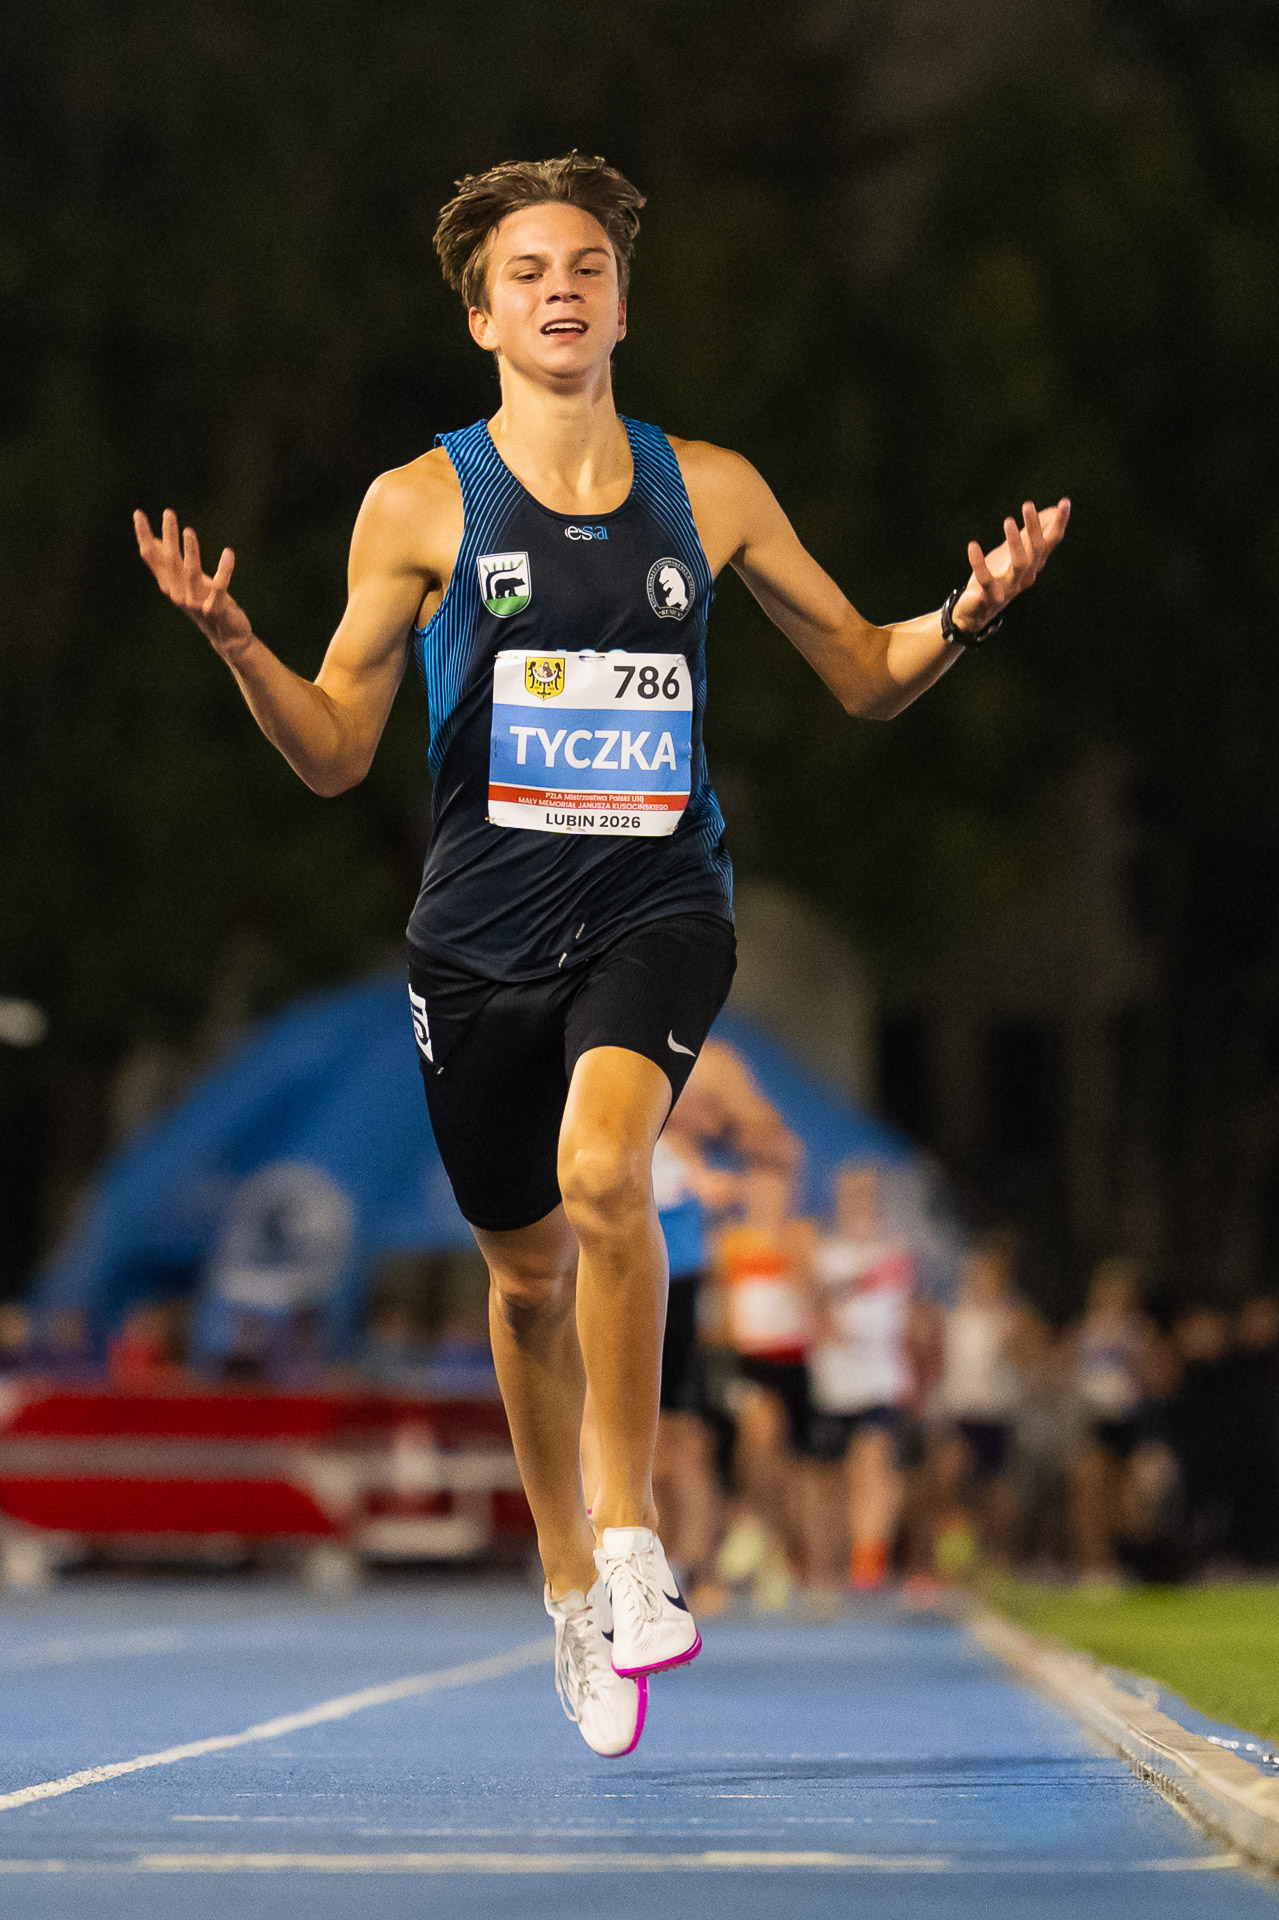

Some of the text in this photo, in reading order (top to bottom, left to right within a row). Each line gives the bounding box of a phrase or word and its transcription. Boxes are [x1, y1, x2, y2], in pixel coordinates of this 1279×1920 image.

[565, 526, 608, 540] esa
[614, 666, 680, 699] 786
[509, 725, 677, 770] TYCZKA
[546, 792, 563, 800] PZLA
[564, 793, 608, 802] Mistrzostwa
[578, 802, 611, 810] JANUSZA
[546, 813, 641, 828] LUBIN 2026
